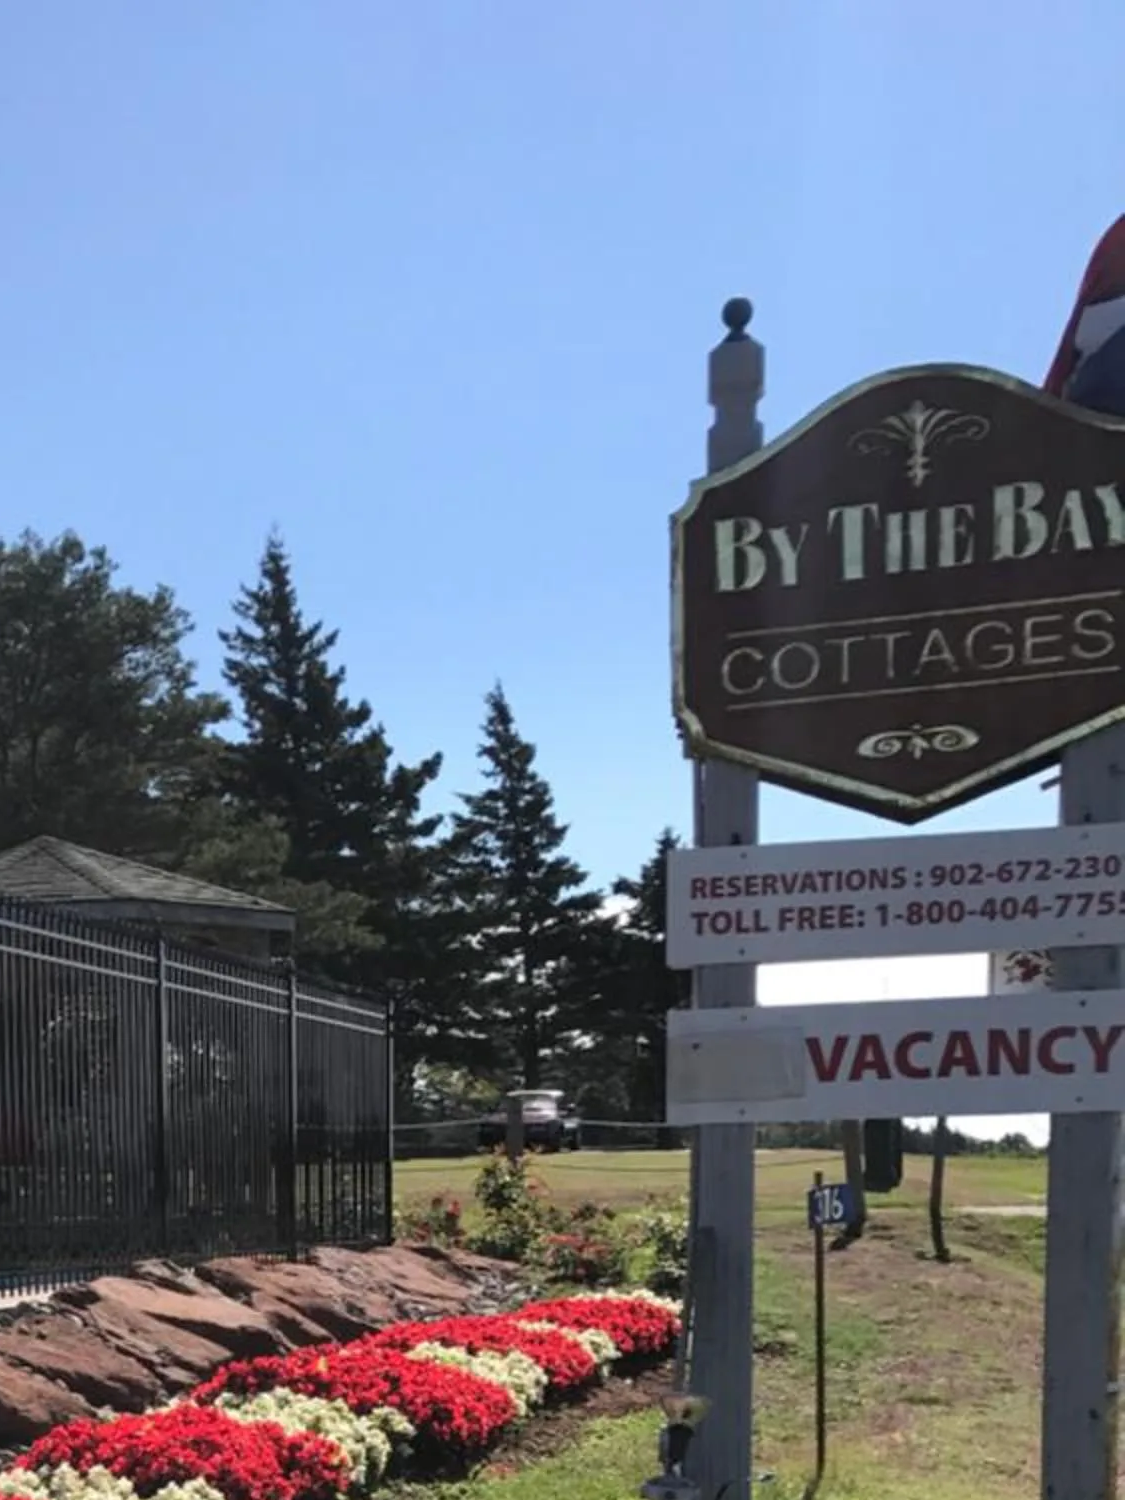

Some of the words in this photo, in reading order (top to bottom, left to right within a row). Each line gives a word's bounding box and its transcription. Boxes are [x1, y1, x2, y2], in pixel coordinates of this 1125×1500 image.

[714, 517, 809, 593] BY
[827, 502, 975, 581] THE
[992, 481, 1125, 562] BAY
[721, 608, 1116, 696] COTTAGES
[690, 908, 770, 936] TOLL
[777, 903, 866, 932] FREE:
[805, 1025, 1125, 1083] VACANCY
